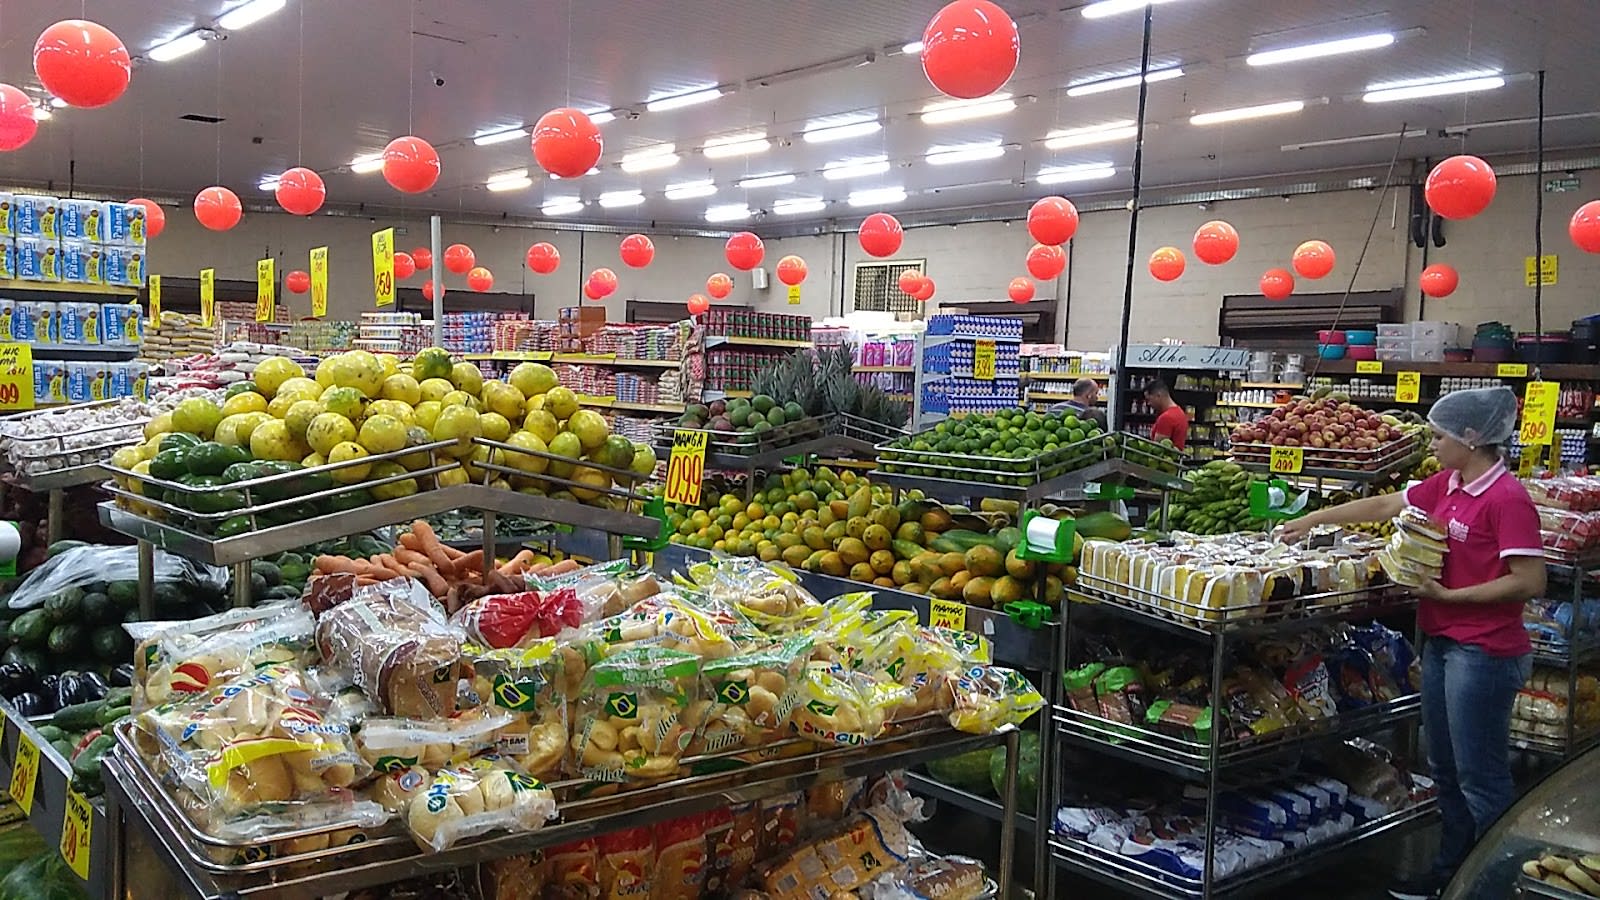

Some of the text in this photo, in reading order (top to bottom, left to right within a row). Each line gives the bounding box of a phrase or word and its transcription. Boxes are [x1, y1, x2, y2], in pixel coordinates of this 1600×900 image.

[21, 200, 33, 234] Paloma
[65, 204, 77, 237] Paloma
[112, 205, 123, 239] Paloma
[22, 242, 33, 276] Paloma
[68, 247, 79, 279] Paloma
[16, 307, 27, 339] Paloma
[65, 307, 76, 340] Paloma
[108, 307, 119, 340] Paloma
[72, 367, 84, 400] Paloma
[672, 431, 704, 448] MANGA
[1521, 421, 1547, 441] 599
